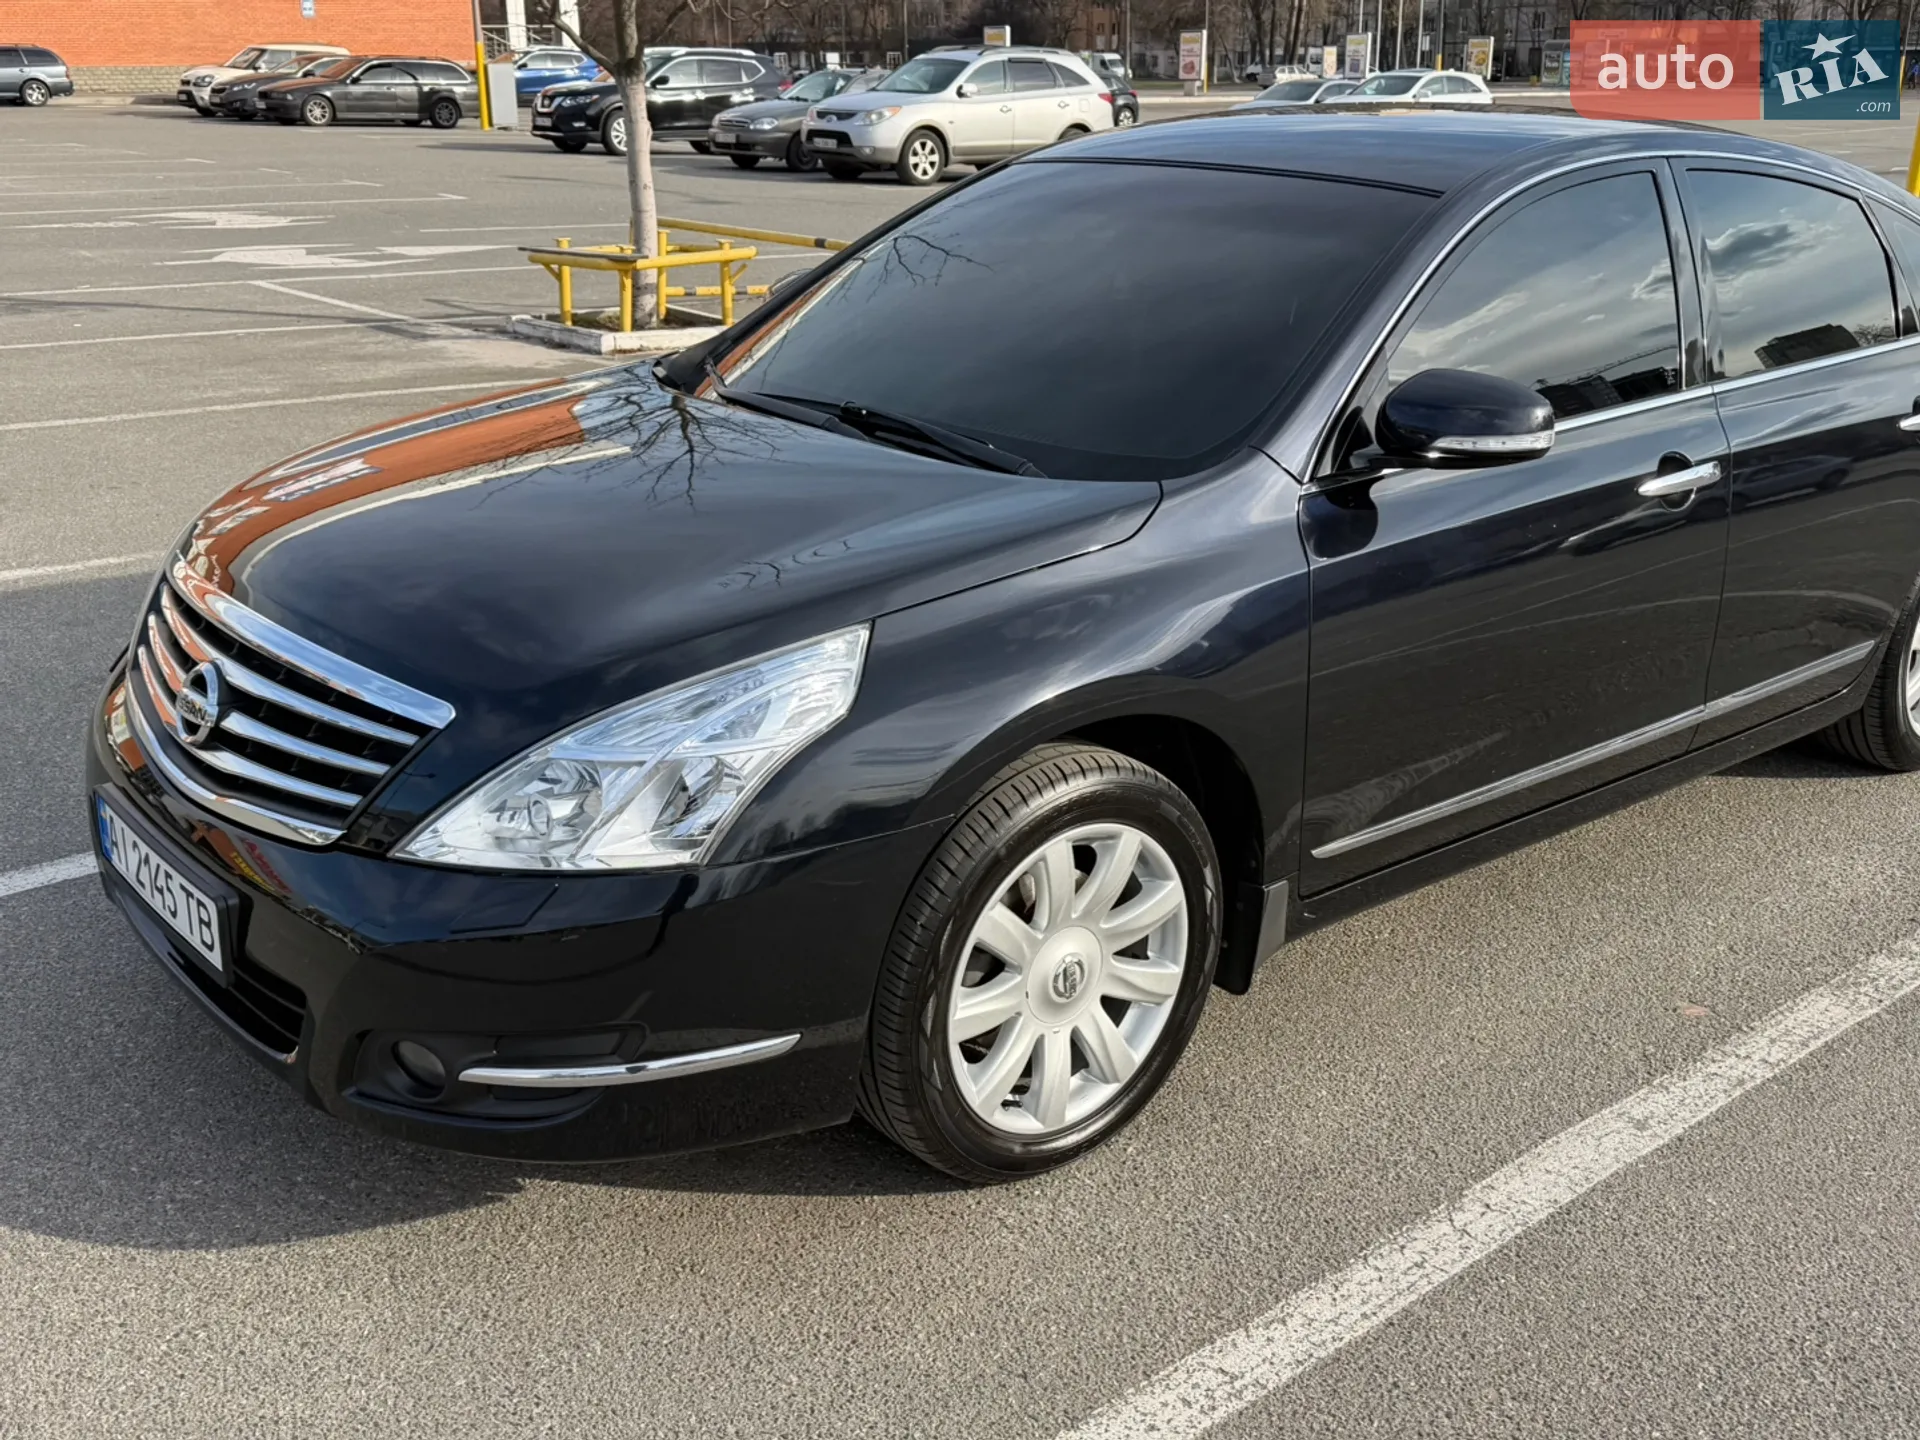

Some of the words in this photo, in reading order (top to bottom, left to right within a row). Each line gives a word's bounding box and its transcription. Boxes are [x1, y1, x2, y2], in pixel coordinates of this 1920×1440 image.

[109, 813, 130, 873] AI
[131, 839, 178, 920] 2145
[179, 883, 215, 954] TB
